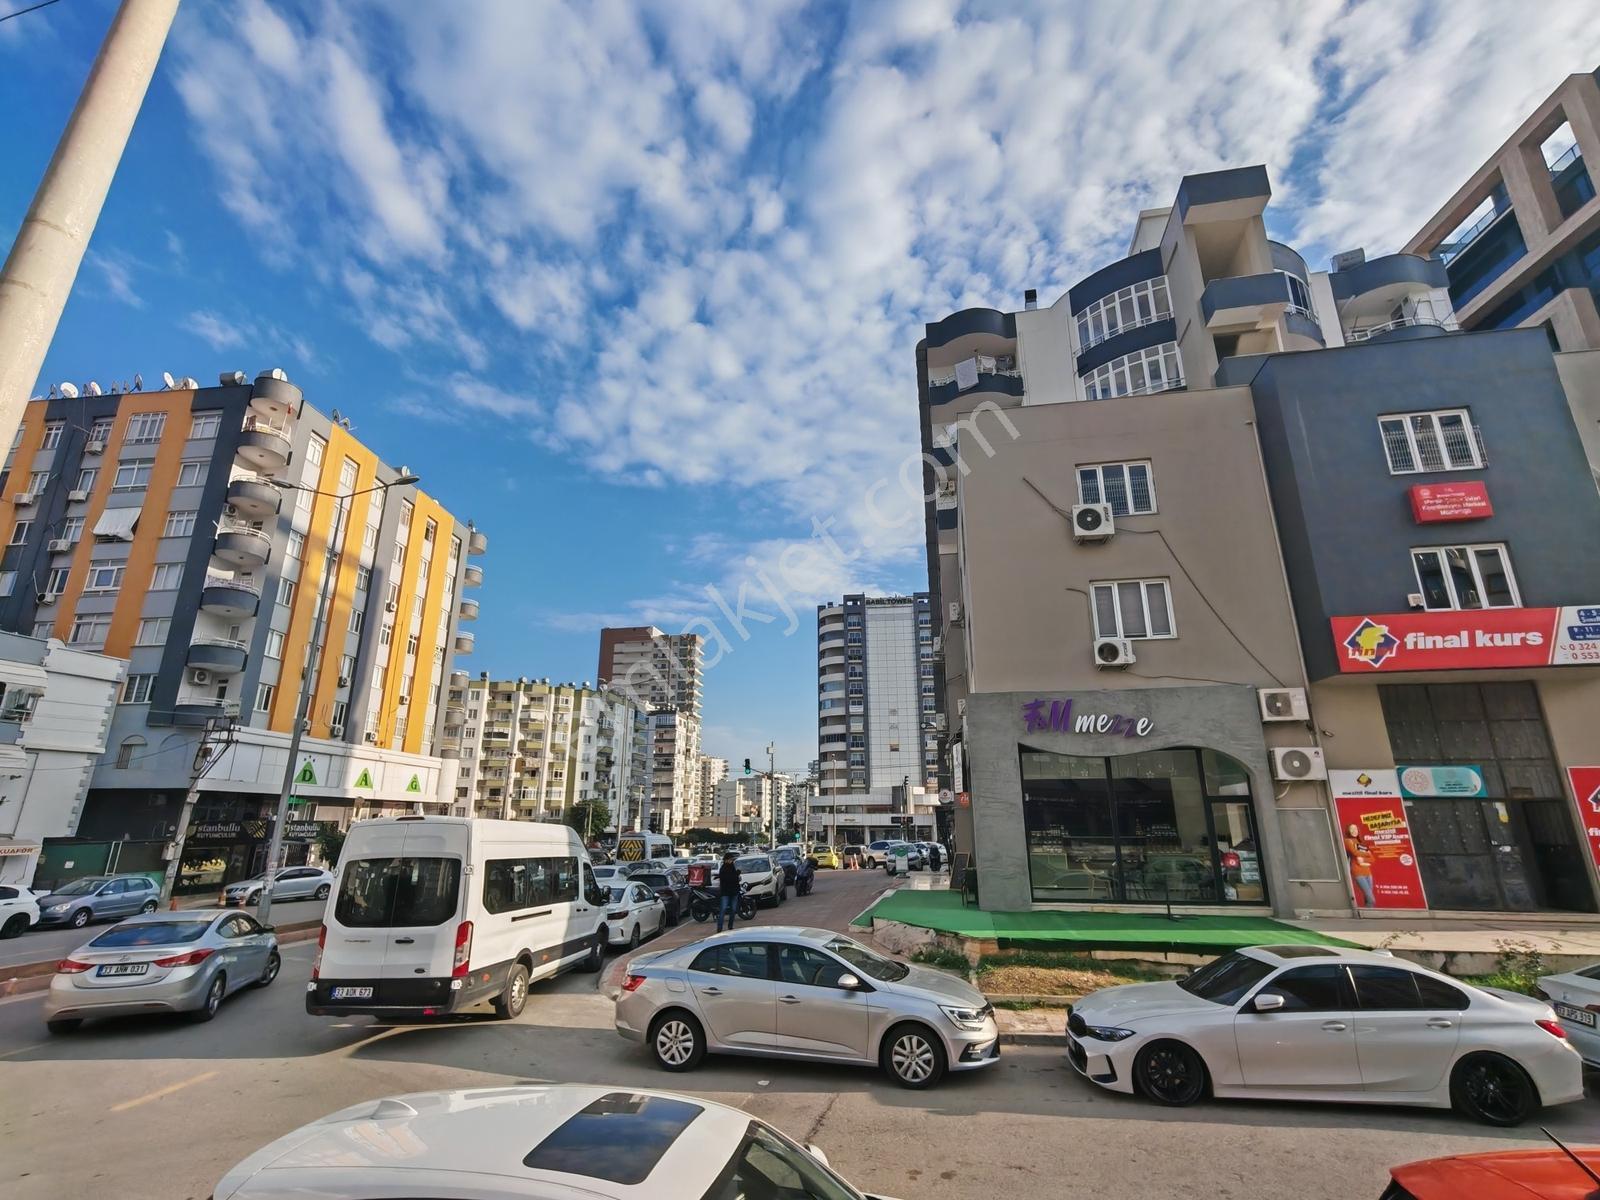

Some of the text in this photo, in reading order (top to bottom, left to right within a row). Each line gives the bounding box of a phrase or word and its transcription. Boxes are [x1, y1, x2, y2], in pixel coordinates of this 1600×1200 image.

[1404, 630, 1544, 650] final kurs
[301, 769, 313, 782] D
[360, 773, 369, 786] A
